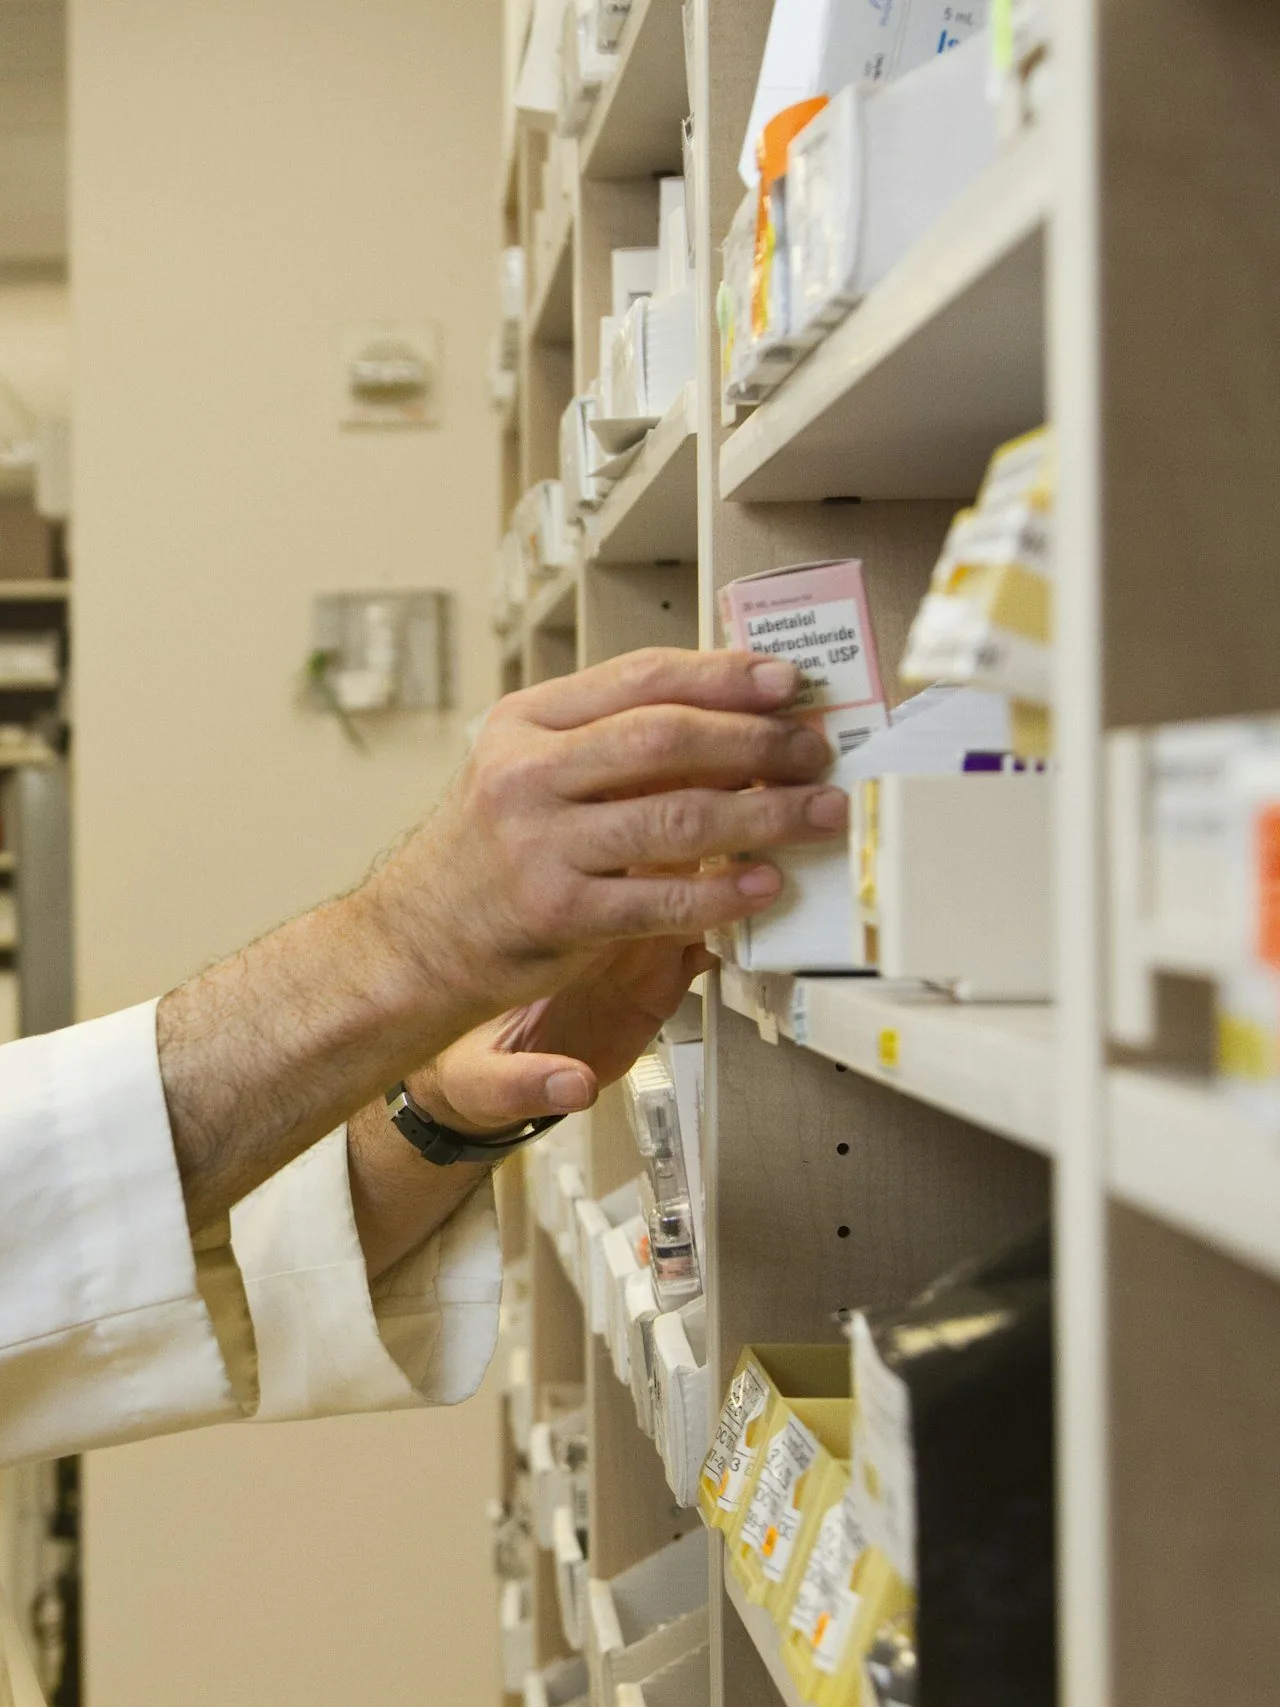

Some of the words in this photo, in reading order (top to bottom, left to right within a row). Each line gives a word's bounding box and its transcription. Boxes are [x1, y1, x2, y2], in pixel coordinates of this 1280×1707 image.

[748, 610, 816, 637] Labetalol
[751, 626, 856, 654] Hydrochloride
[827, 645, 860, 665] USP
